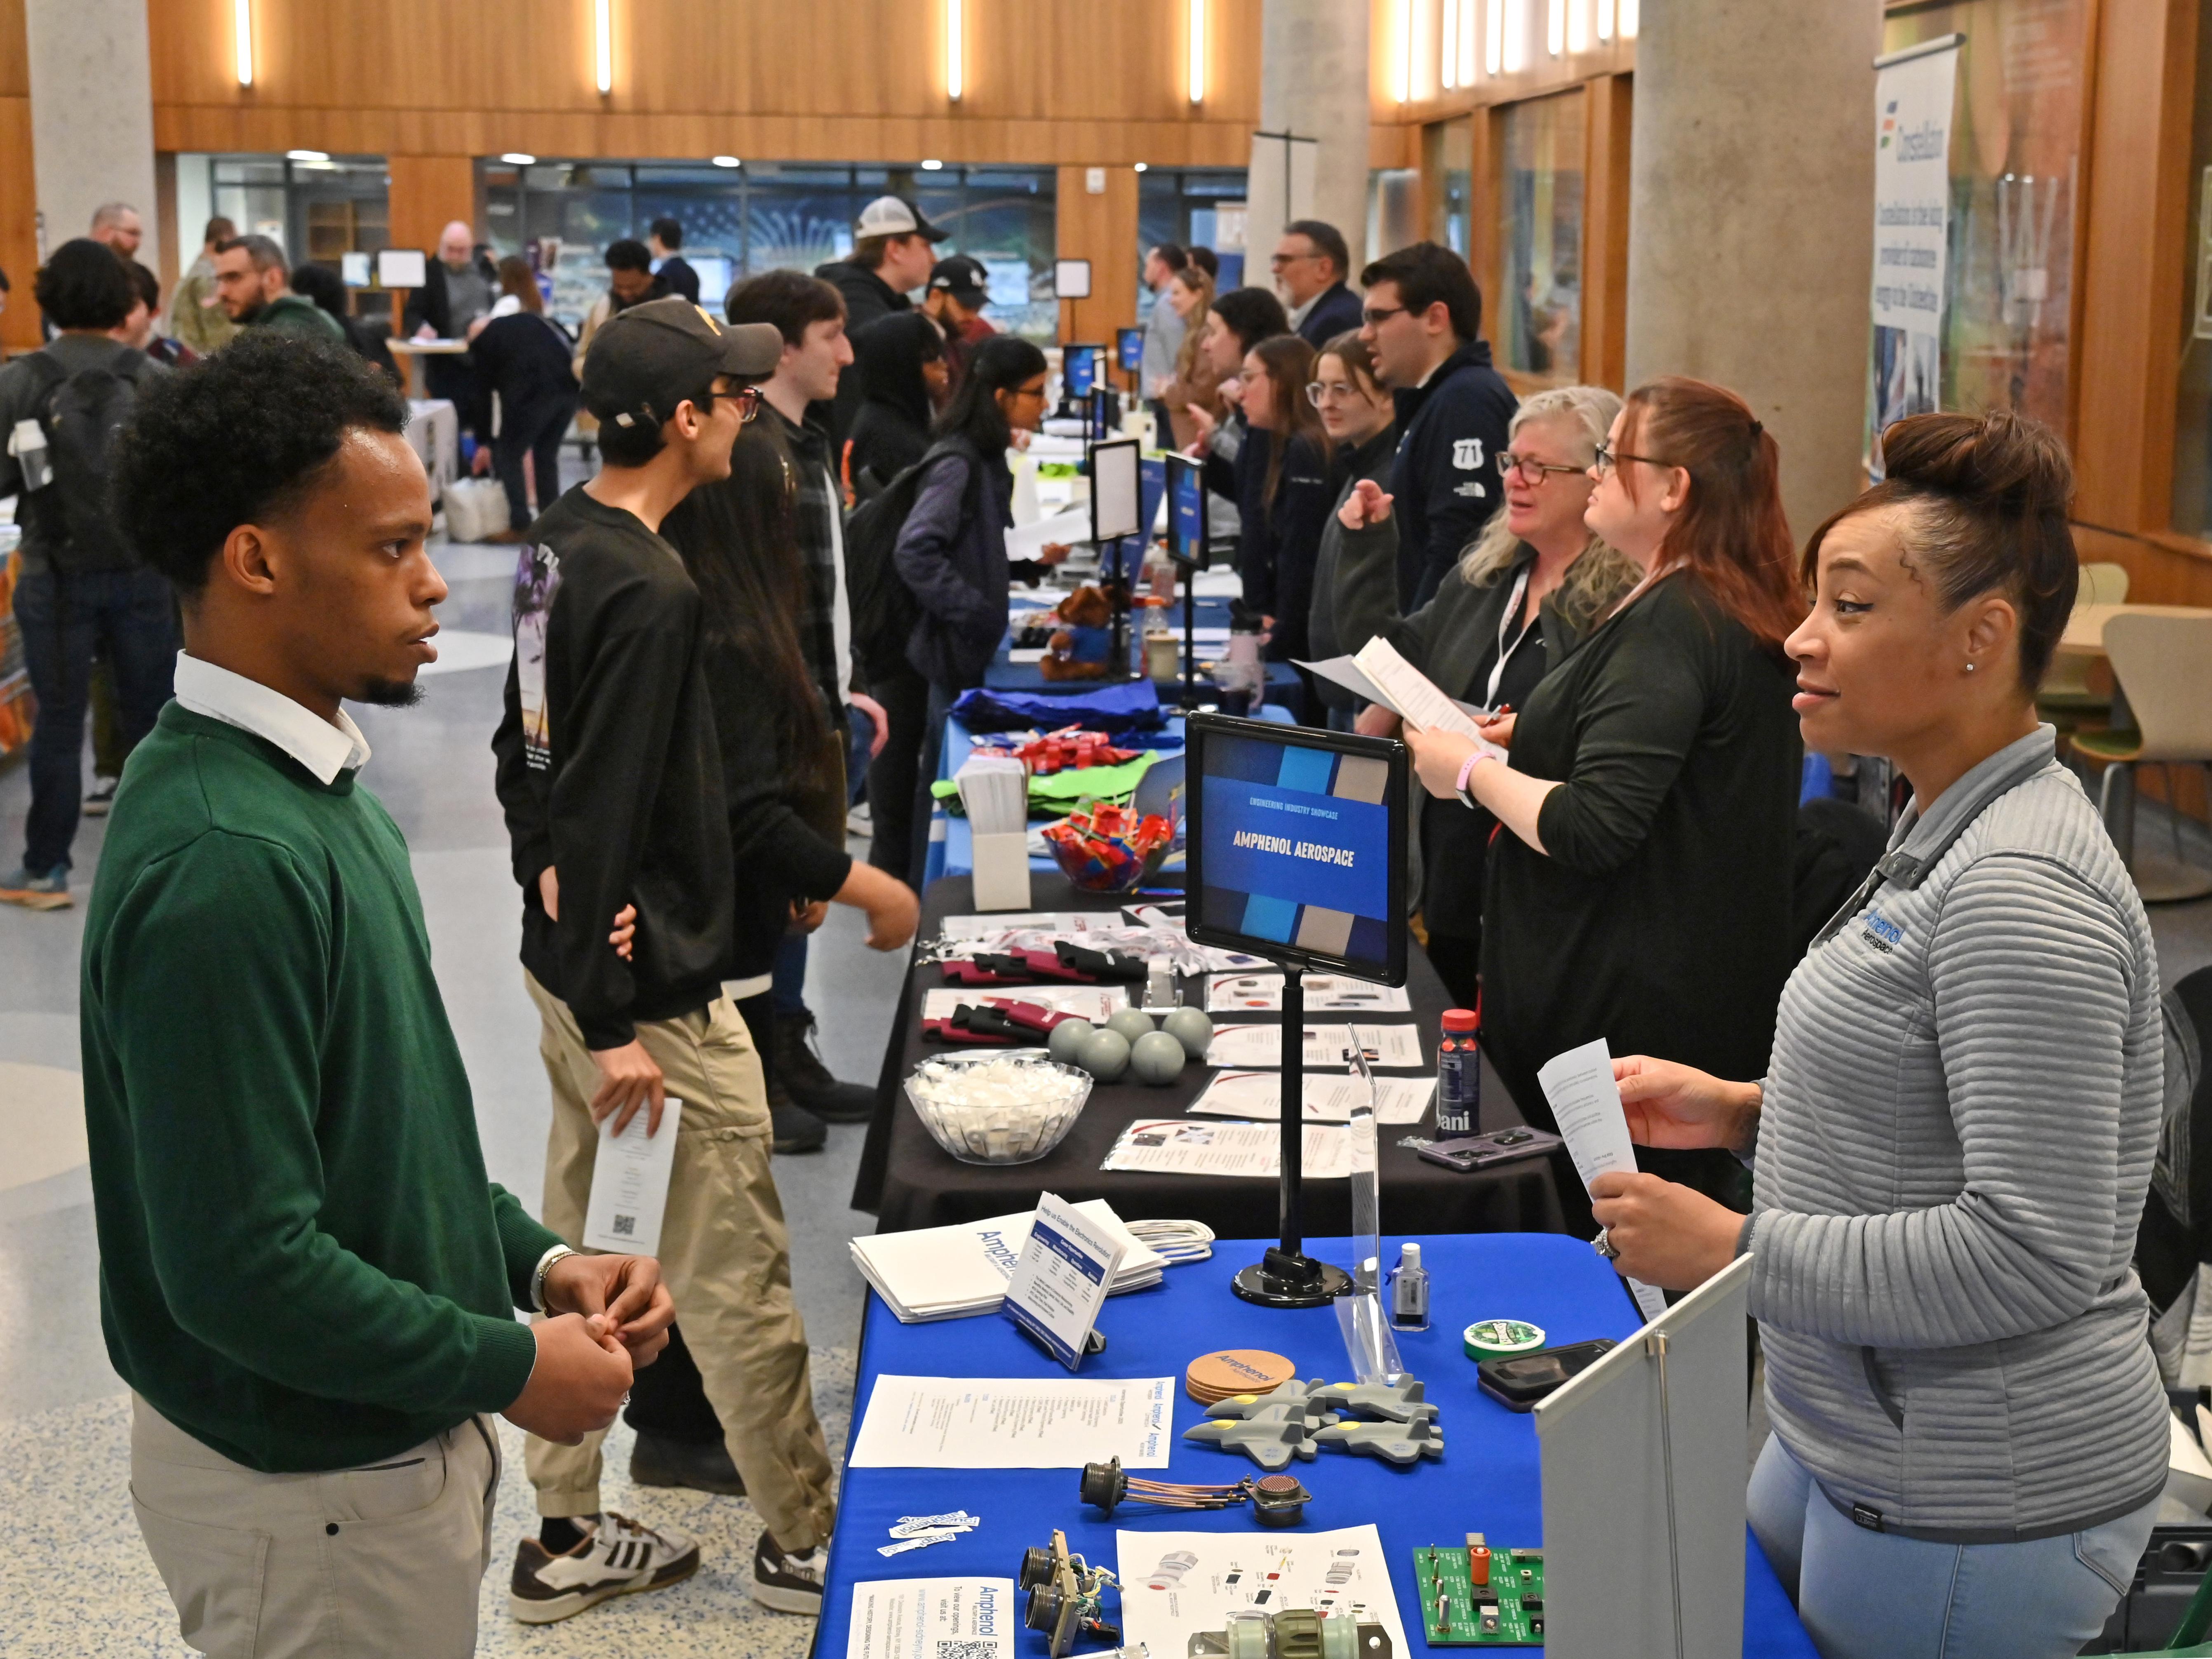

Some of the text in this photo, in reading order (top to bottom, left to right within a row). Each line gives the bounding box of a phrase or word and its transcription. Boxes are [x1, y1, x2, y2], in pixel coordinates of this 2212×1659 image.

[1459, 445, 1477, 463] 71
[1250, 797, 1339, 820] ENGINEERING INDUSTRY SHOWCASE
[1233, 830, 1355, 867] AMPHENOL AEROSPACE
[1041, 1205, 1051, 1216] Help
[1056, 1215, 1069, 1228] Enable
[1075, 1228, 1093, 1246] Electronics
[1215, 1355, 1275, 1381] Amphenol
[1153, 1381, 1165, 1399] Amphenol
[1150, 1403, 1164, 1423] Amphenol
[1145, 1433, 1160, 1457] Amphenol
[940, 1599, 948, 1608] visit
[975, 1586, 999, 1636] Amphenol
[950, 1612, 961, 1635] openings,
